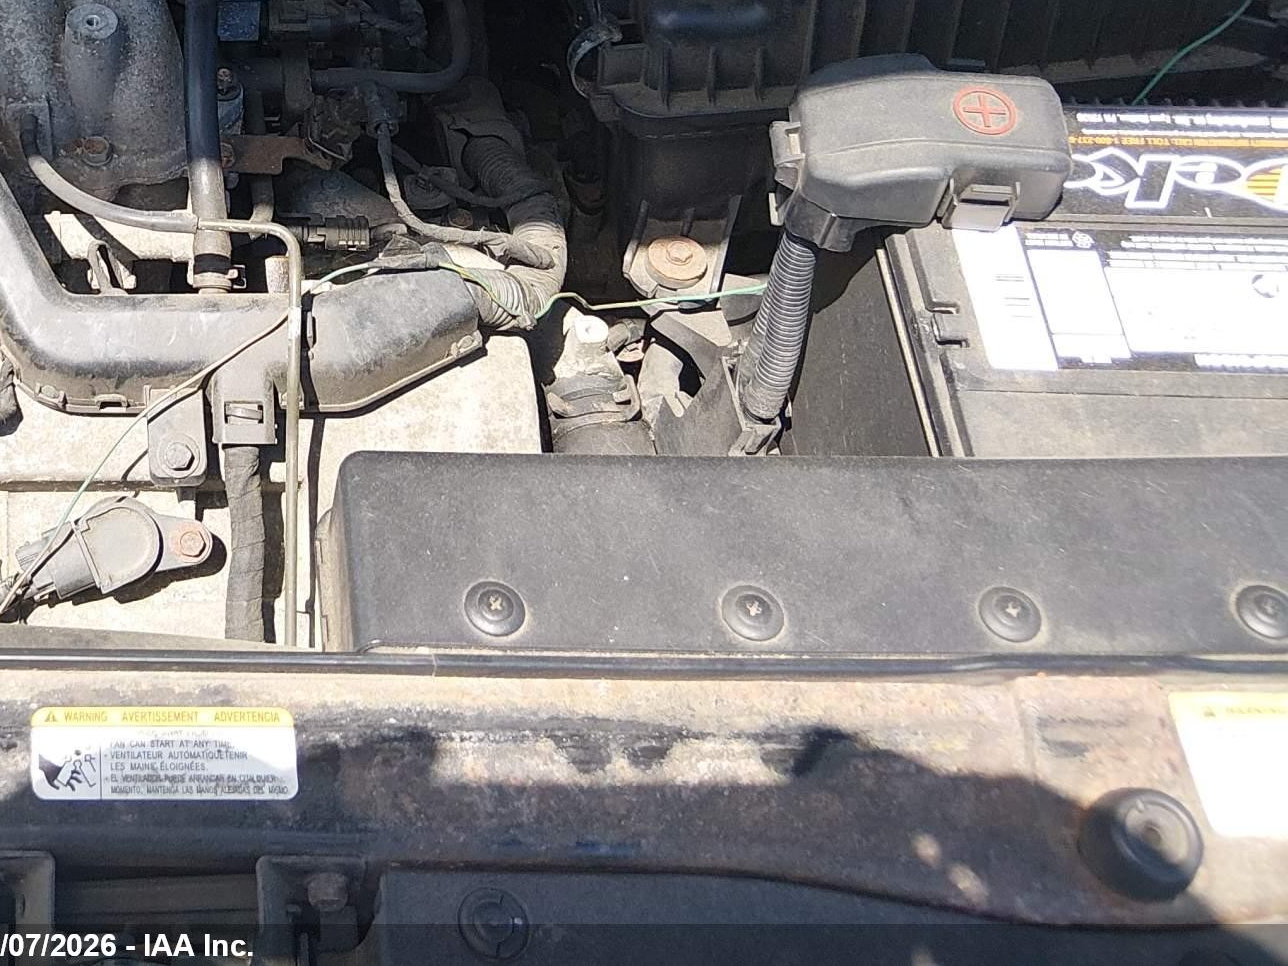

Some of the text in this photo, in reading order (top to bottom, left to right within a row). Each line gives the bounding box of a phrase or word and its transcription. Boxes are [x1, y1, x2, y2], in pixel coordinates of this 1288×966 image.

[64, 712, 280, 722] WARNING AVERTISSEMENT ADVERTENCIA
[150, 739, 175, 747] START
[179, 739, 190, 747] AT
[193, 739, 210, 748] ANY
[110, 750, 163, 760] VENTILATEUR
[110, 761, 126, 771] LES
